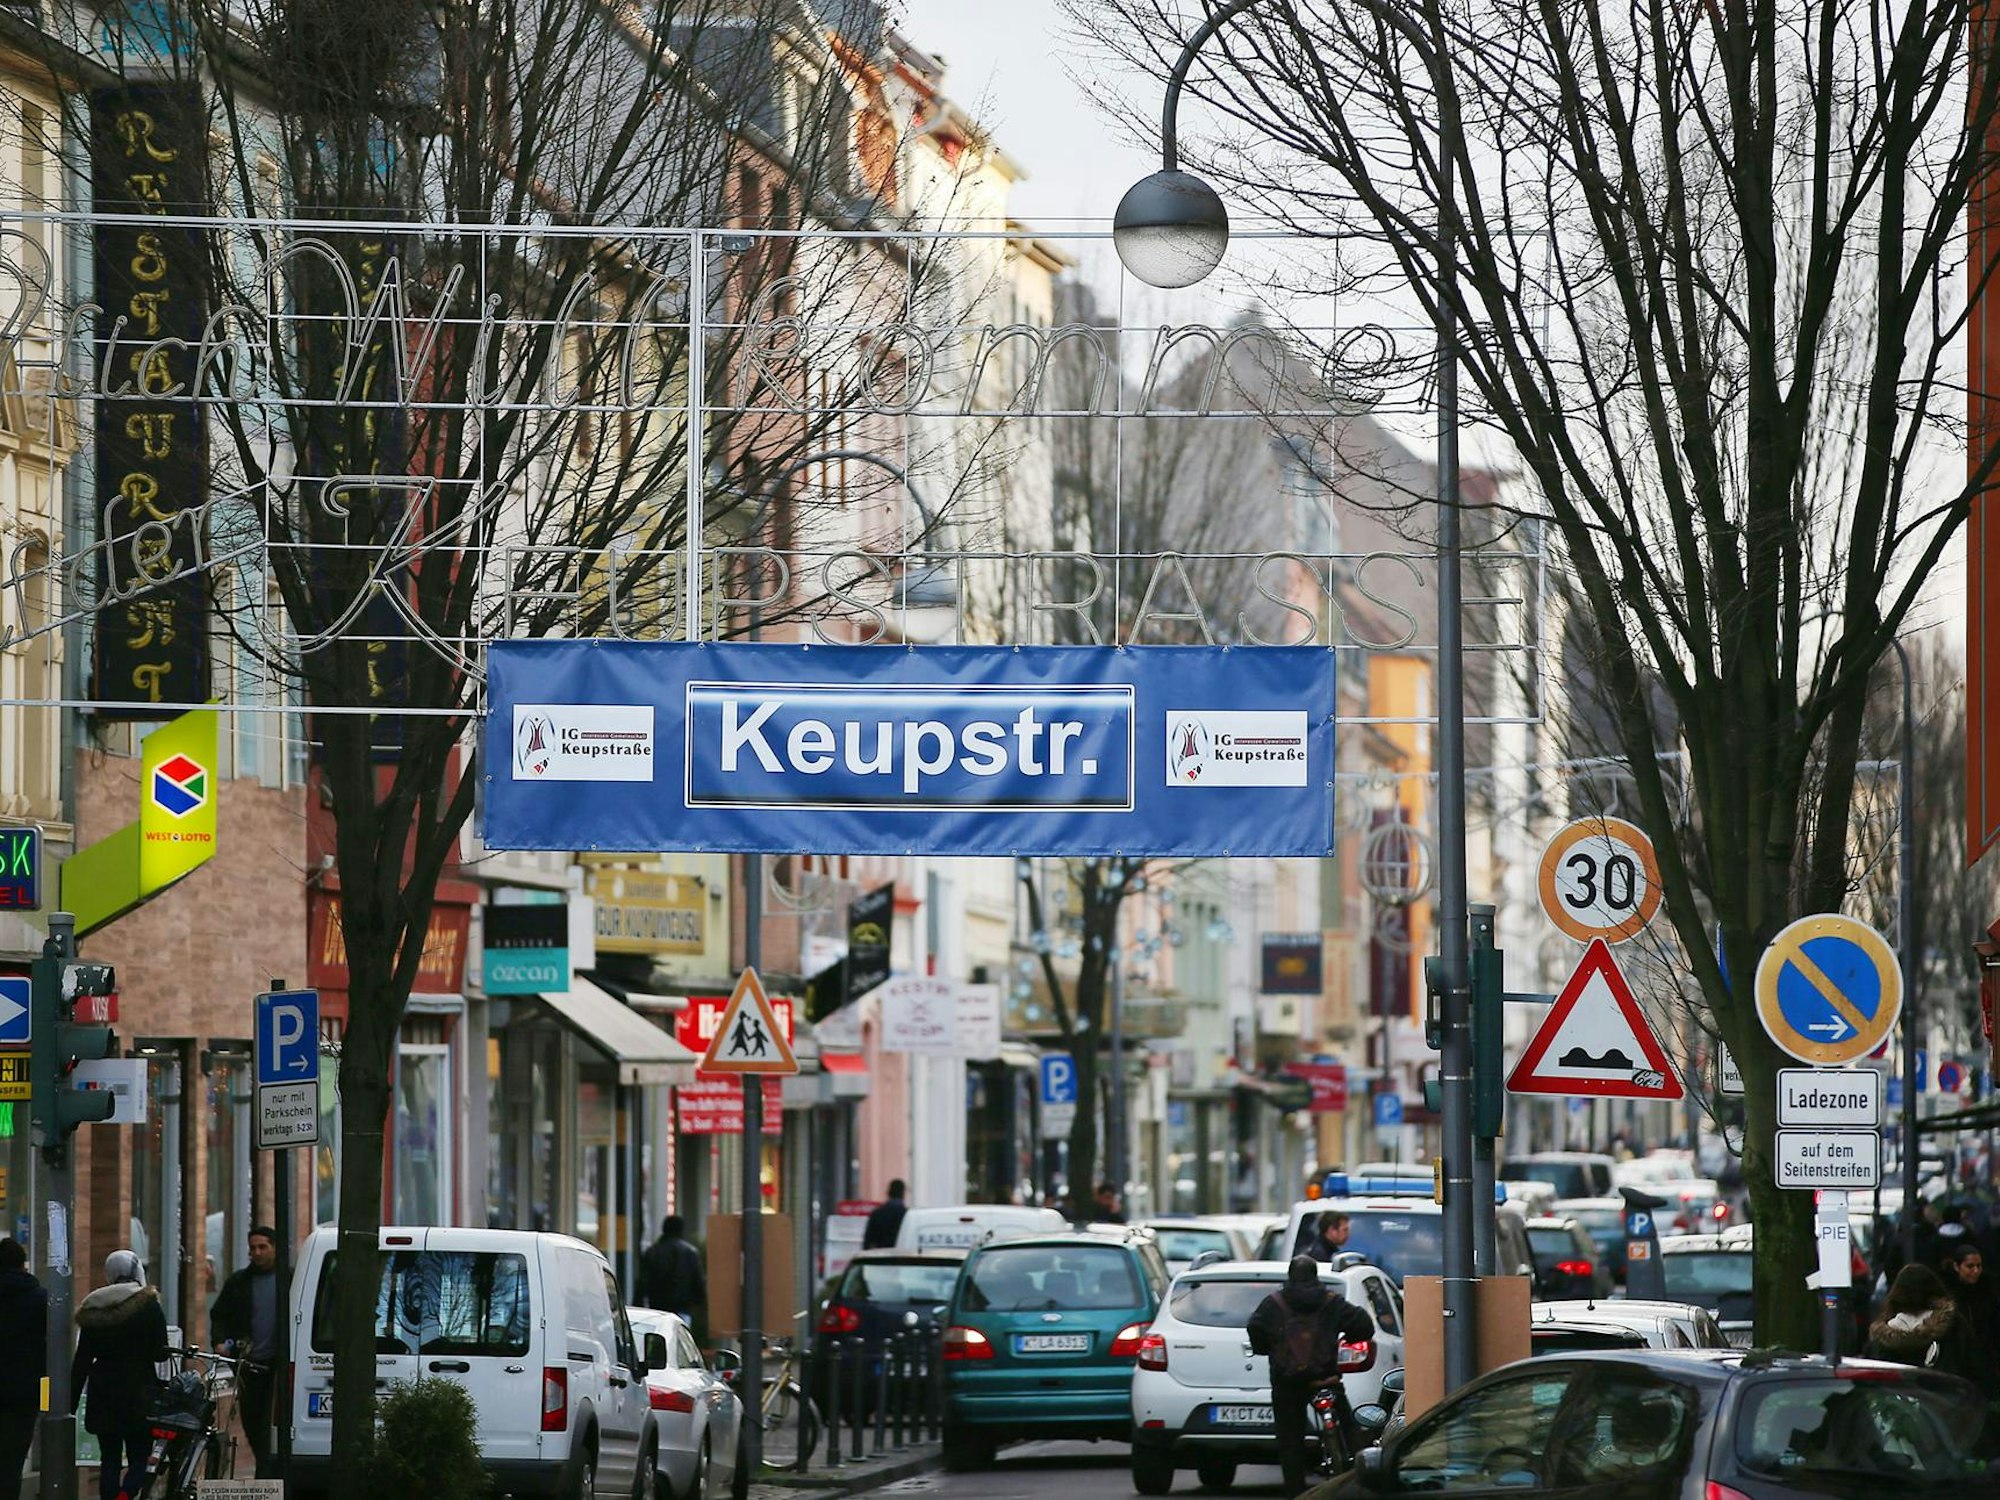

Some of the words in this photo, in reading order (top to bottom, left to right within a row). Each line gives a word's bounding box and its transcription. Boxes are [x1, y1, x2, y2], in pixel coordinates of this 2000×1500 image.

[561, 728, 579, 740] IG
[1214, 734, 1231, 746] IG
[561, 743, 651, 758] Keupstraße
[720, 700, 1097, 794] Keupstr.
[1214, 748, 1305, 764] Keupstraße
[146, 832, 171, 840] WEST
[181, 833, 211, 841] LOTTO
[1565, 854, 1635, 910] 30
[272, 1005, 304, 1071] P
[1049, 1060, 1070, 1096] P
[272, 1094, 287, 1103] nur
[291, 1090, 305, 1102] mit
[1789, 1088, 1868, 1109] Ladezone
[265, 1105, 313, 1119] Parkschein
[1801, 1143, 1821, 1157] auf
[1828, 1143, 1854, 1157] dem
[1785, 1162, 1871, 1177] Seitenstreifen
[1634, 1213, 1649, 1234] P
